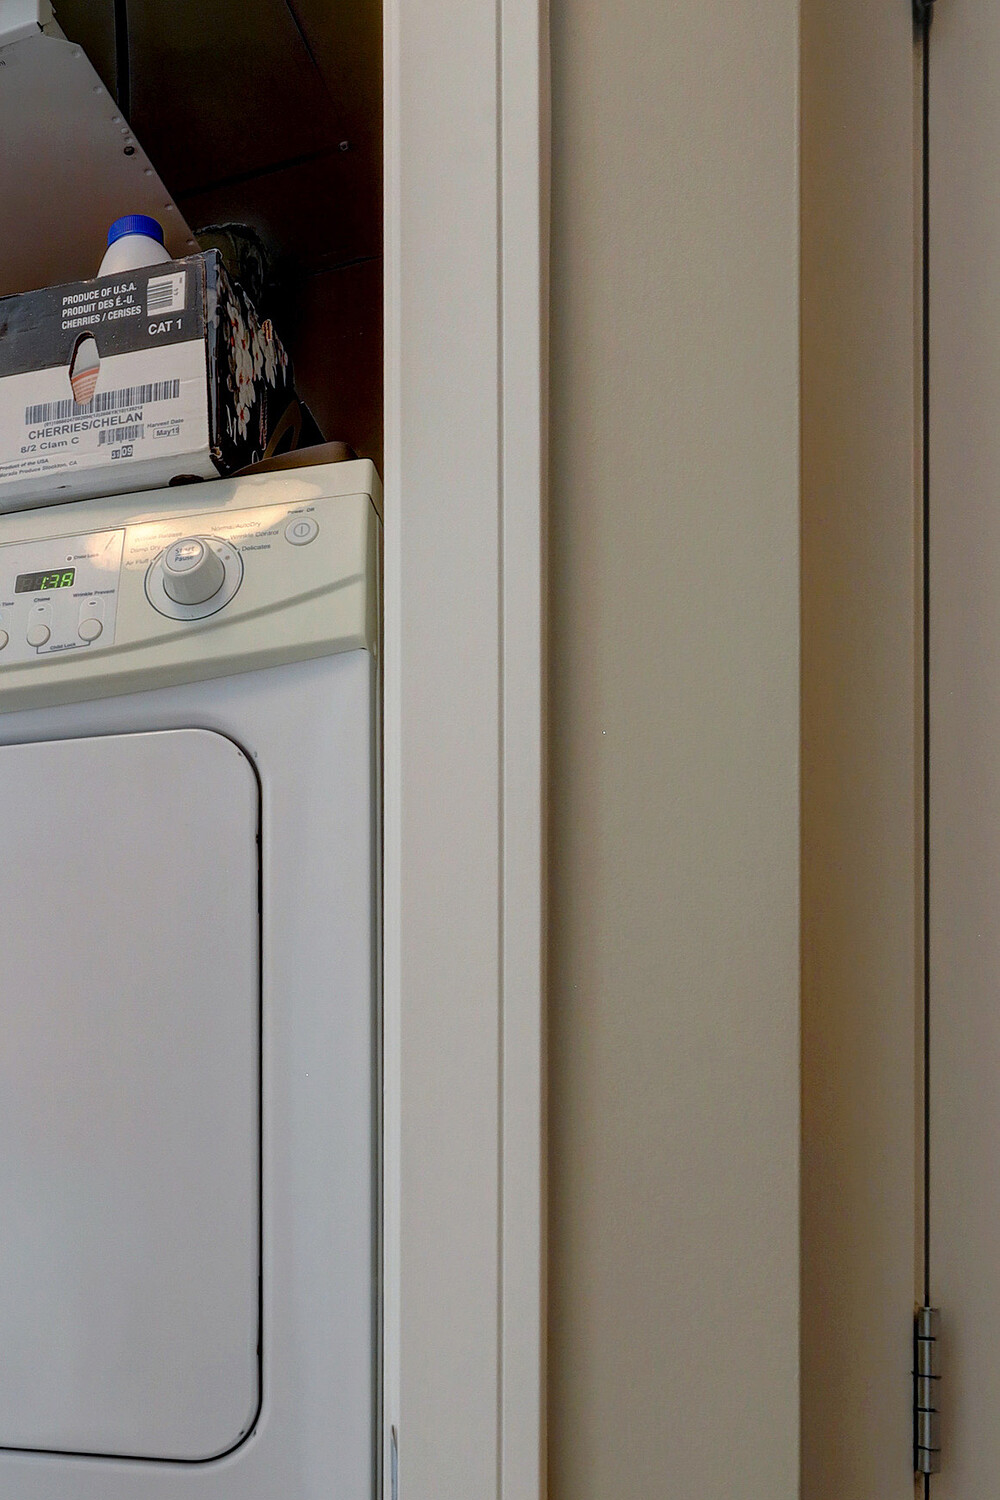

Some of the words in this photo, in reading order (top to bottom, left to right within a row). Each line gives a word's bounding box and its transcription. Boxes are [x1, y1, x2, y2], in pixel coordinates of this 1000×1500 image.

[62, 290, 100, 306] PRODUCE
[101, 287, 112, 297] OF
[114, 282, 137, 294] U.S.A.
[62, 302, 96, 318] PRODUIT
[98, 299, 114, 310] DES
[116, 295, 135, 306] É.-U.
[62, 314, 100, 330] CHERRIES
[108, 306, 142, 320] CERISES
[148, 320, 174, 335] CAT
[176, 318, 182, 330] 1
[28, 412, 144, 440] CHERRIES/CHELAN
[147, 420, 170, 428] Harvest
[20, 444, 37, 454] 8/2
[40, 439, 68, 450] Clam
[71, 436, 80, 444] C
[121, 444, 134, 458] 09
[241, 544, 271, 552] Delicates
